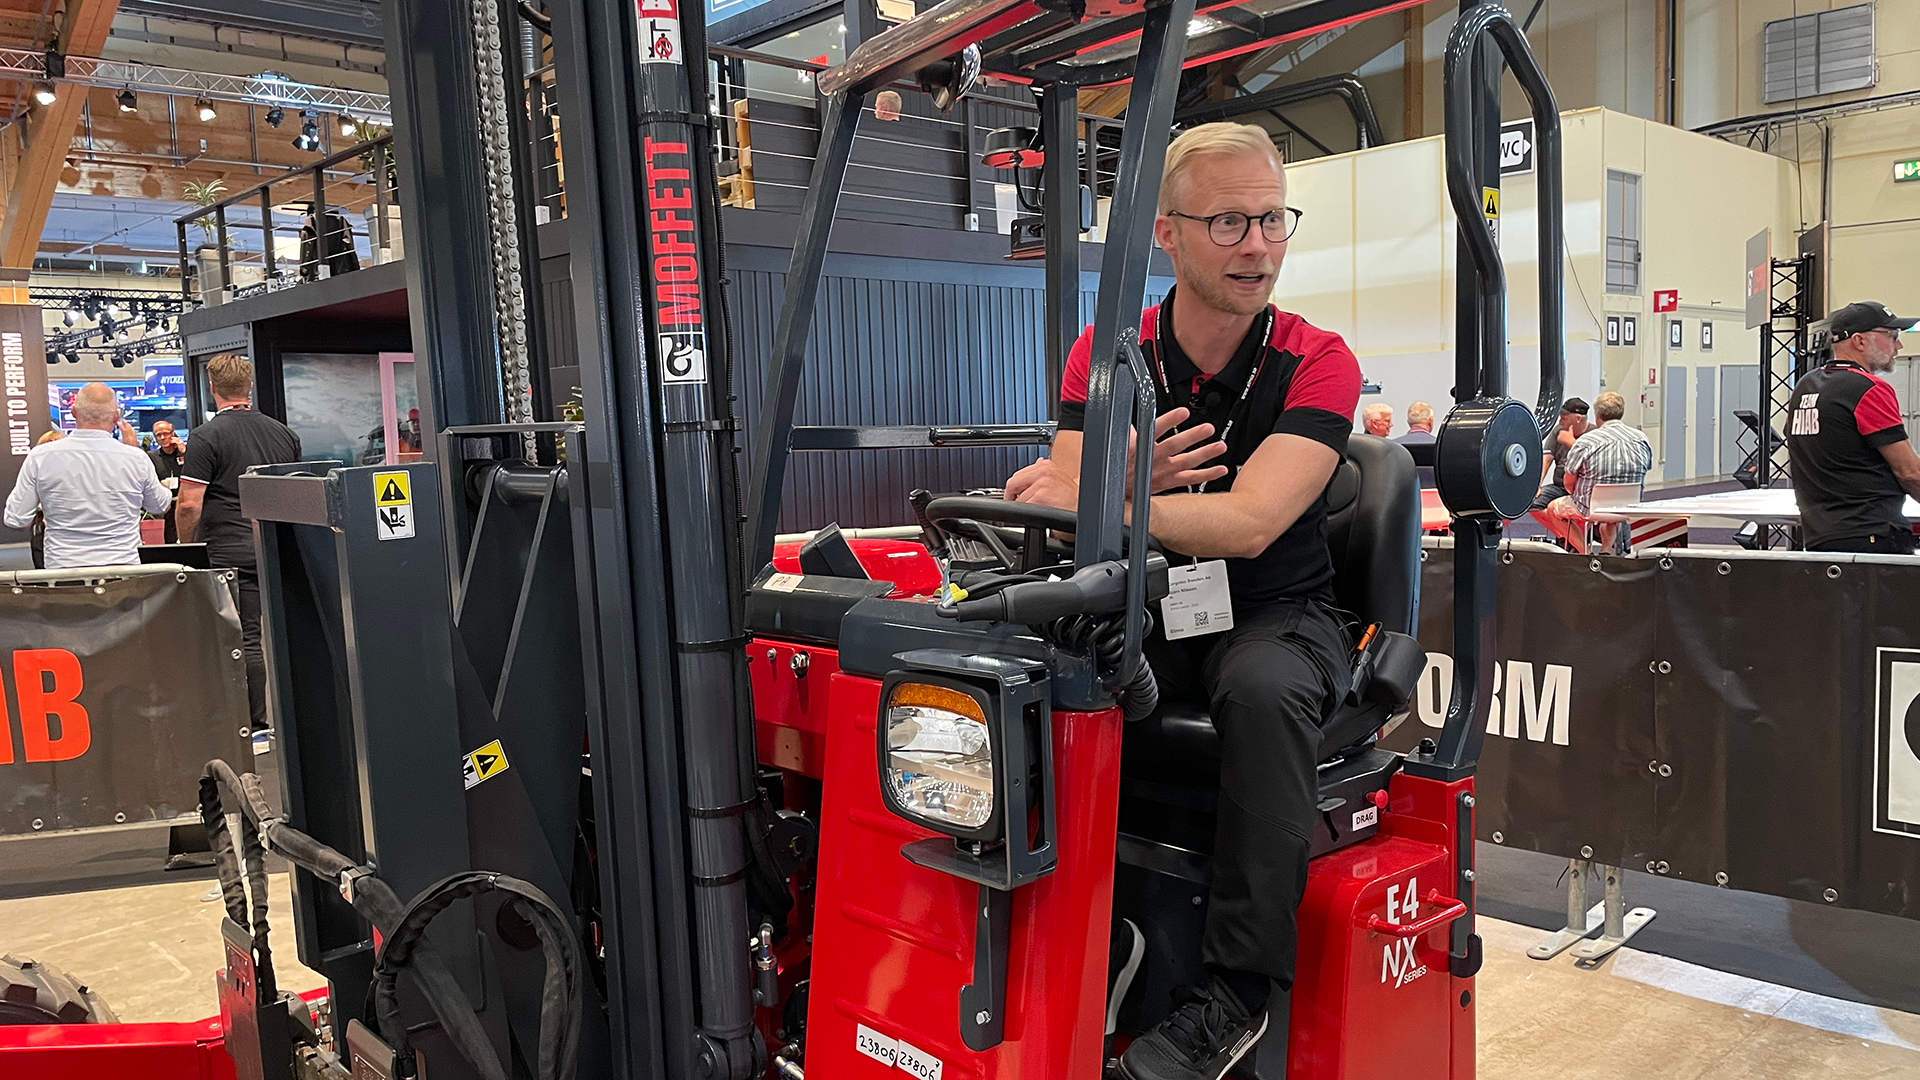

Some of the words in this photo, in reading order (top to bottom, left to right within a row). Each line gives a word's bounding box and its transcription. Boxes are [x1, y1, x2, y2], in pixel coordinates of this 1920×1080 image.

[644, 136, 702, 326] MOFFETT
[1, 332, 26, 396] PERFORM
[7, 399, 28, 417] TO
[1791, 408, 1820, 436] HIAB
[9, 419, 31, 455] BUILT
[0, 648, 92, 766] B
[1355, 811, 1374, 825] DRAG
[1386, 876, 1420, 926] E4
[1381, 935, 1418, 989] NX
[1403, 964, 1427, 984] SERIES
[858, 1034, 896, 1062] 23806
